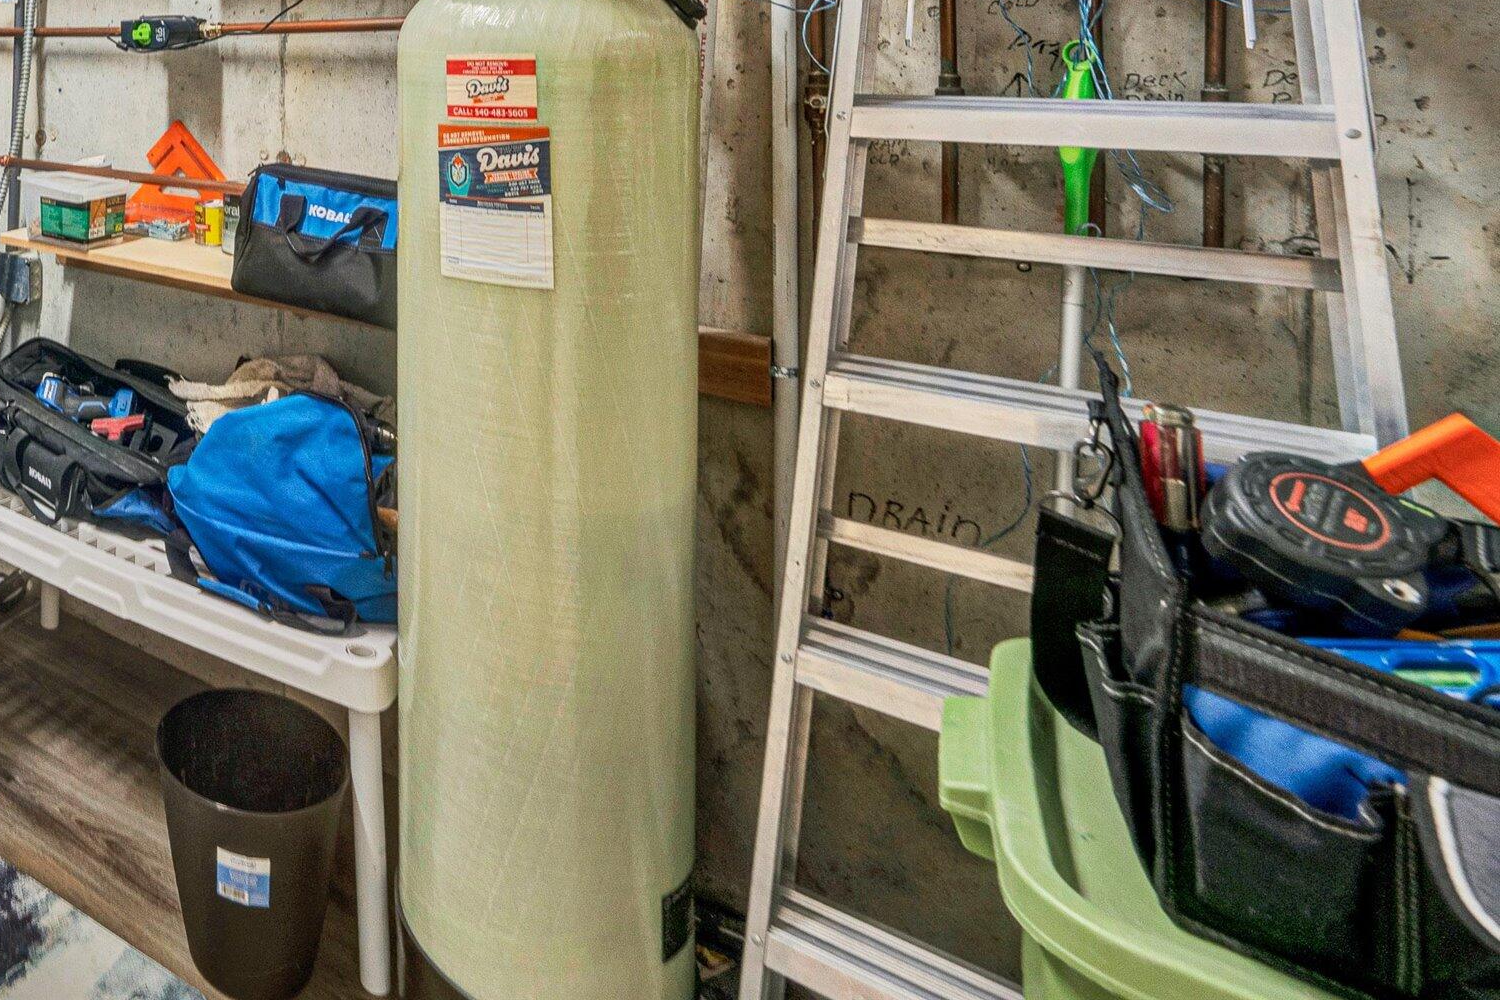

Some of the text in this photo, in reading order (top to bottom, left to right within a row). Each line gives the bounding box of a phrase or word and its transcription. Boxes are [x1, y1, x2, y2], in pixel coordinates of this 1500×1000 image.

[466, 76, 510, 98] Davis
[453, 106, 474, 116] CALL:
[470, 133, 511, 143] INFORMATION
[476, 144, 540, 173] Davis
[308, 203, 352, 224] KOBAL
